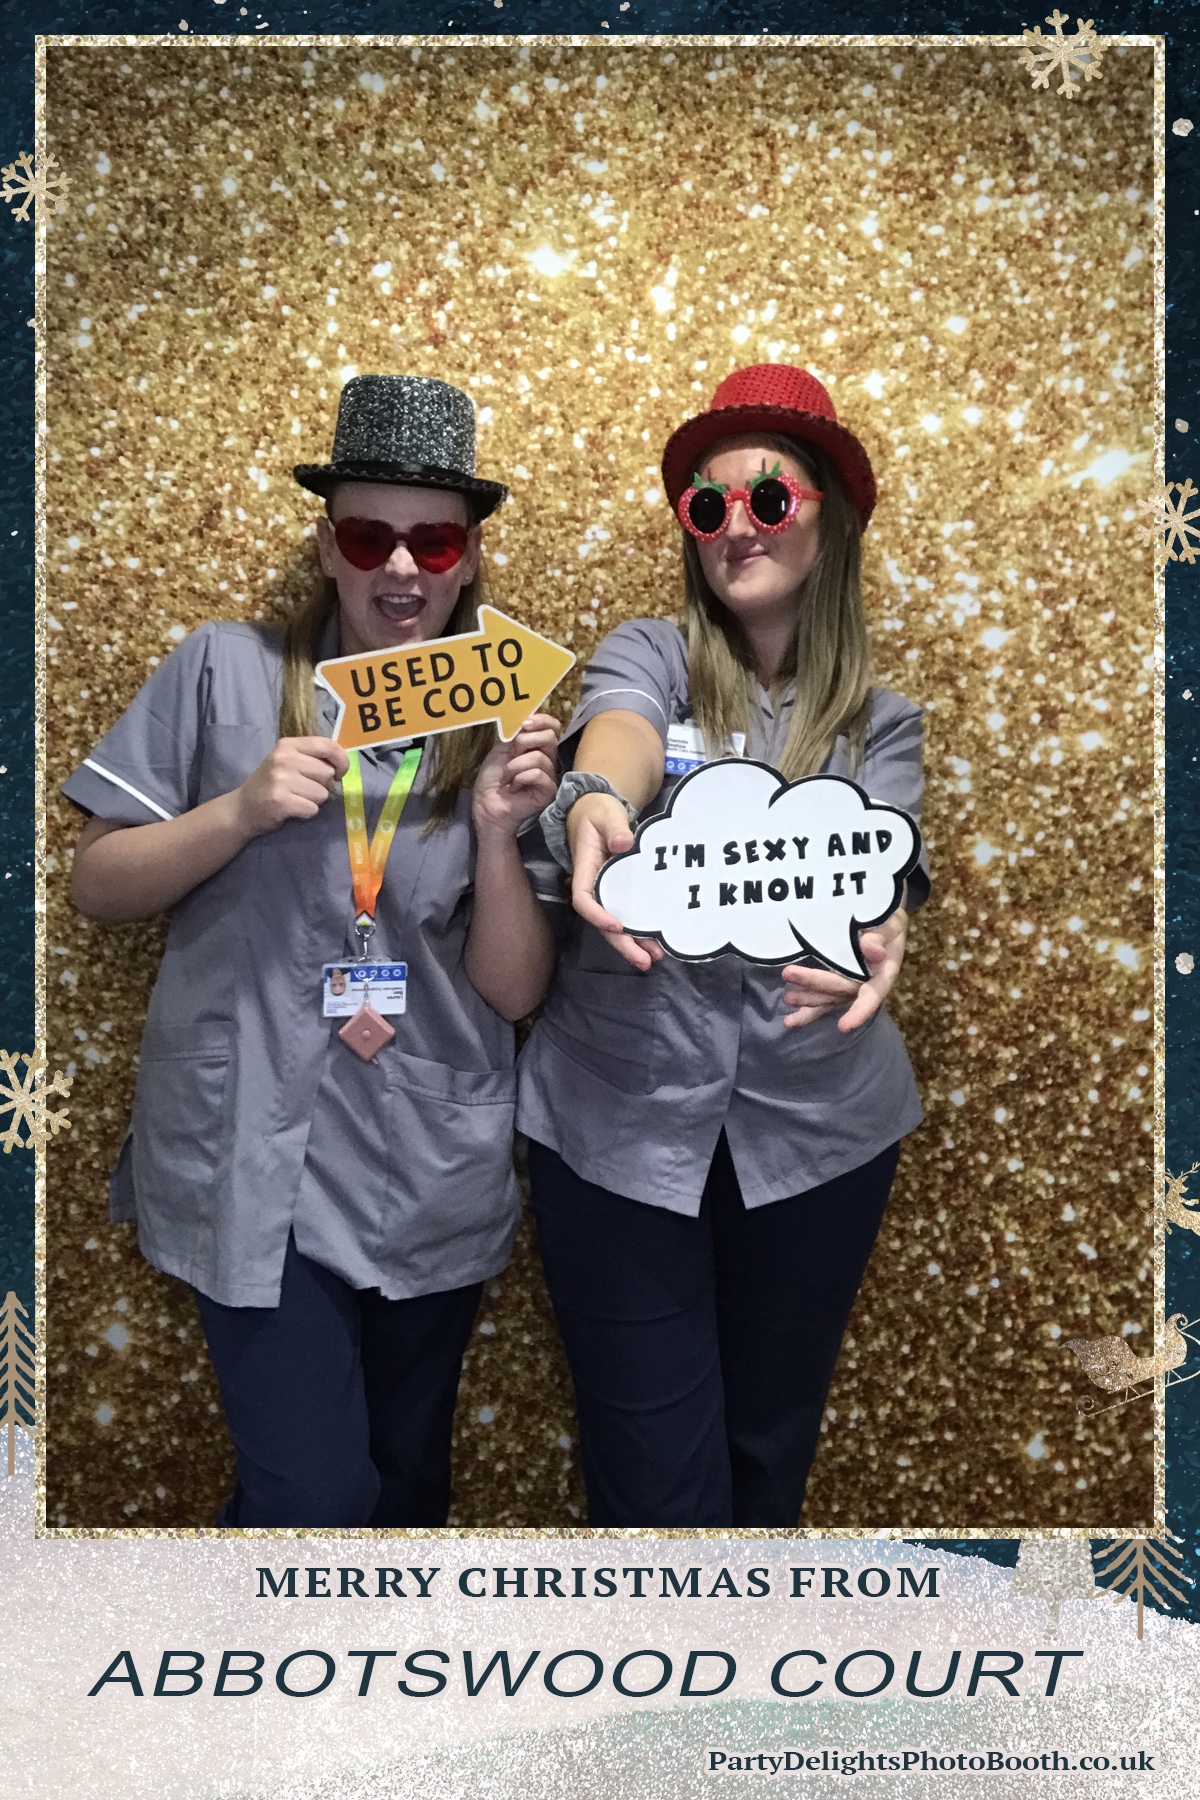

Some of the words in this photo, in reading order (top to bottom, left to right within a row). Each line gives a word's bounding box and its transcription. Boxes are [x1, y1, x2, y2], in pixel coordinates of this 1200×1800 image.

[350, 652, 455, 698] USED
[471, 638, 523, 673] TO
[357, 696, 406, 733] BE
[423, 673, 530, 719] COOL
[654, 843, 705, 871] I'M
[723, 836, 810, 866] SEXY
[827, 829, 893, 857] AND
[687, 884, 701, 910] I
[719, 876, 814, 907] KNOW
[832, 870, 867, 897] IT
